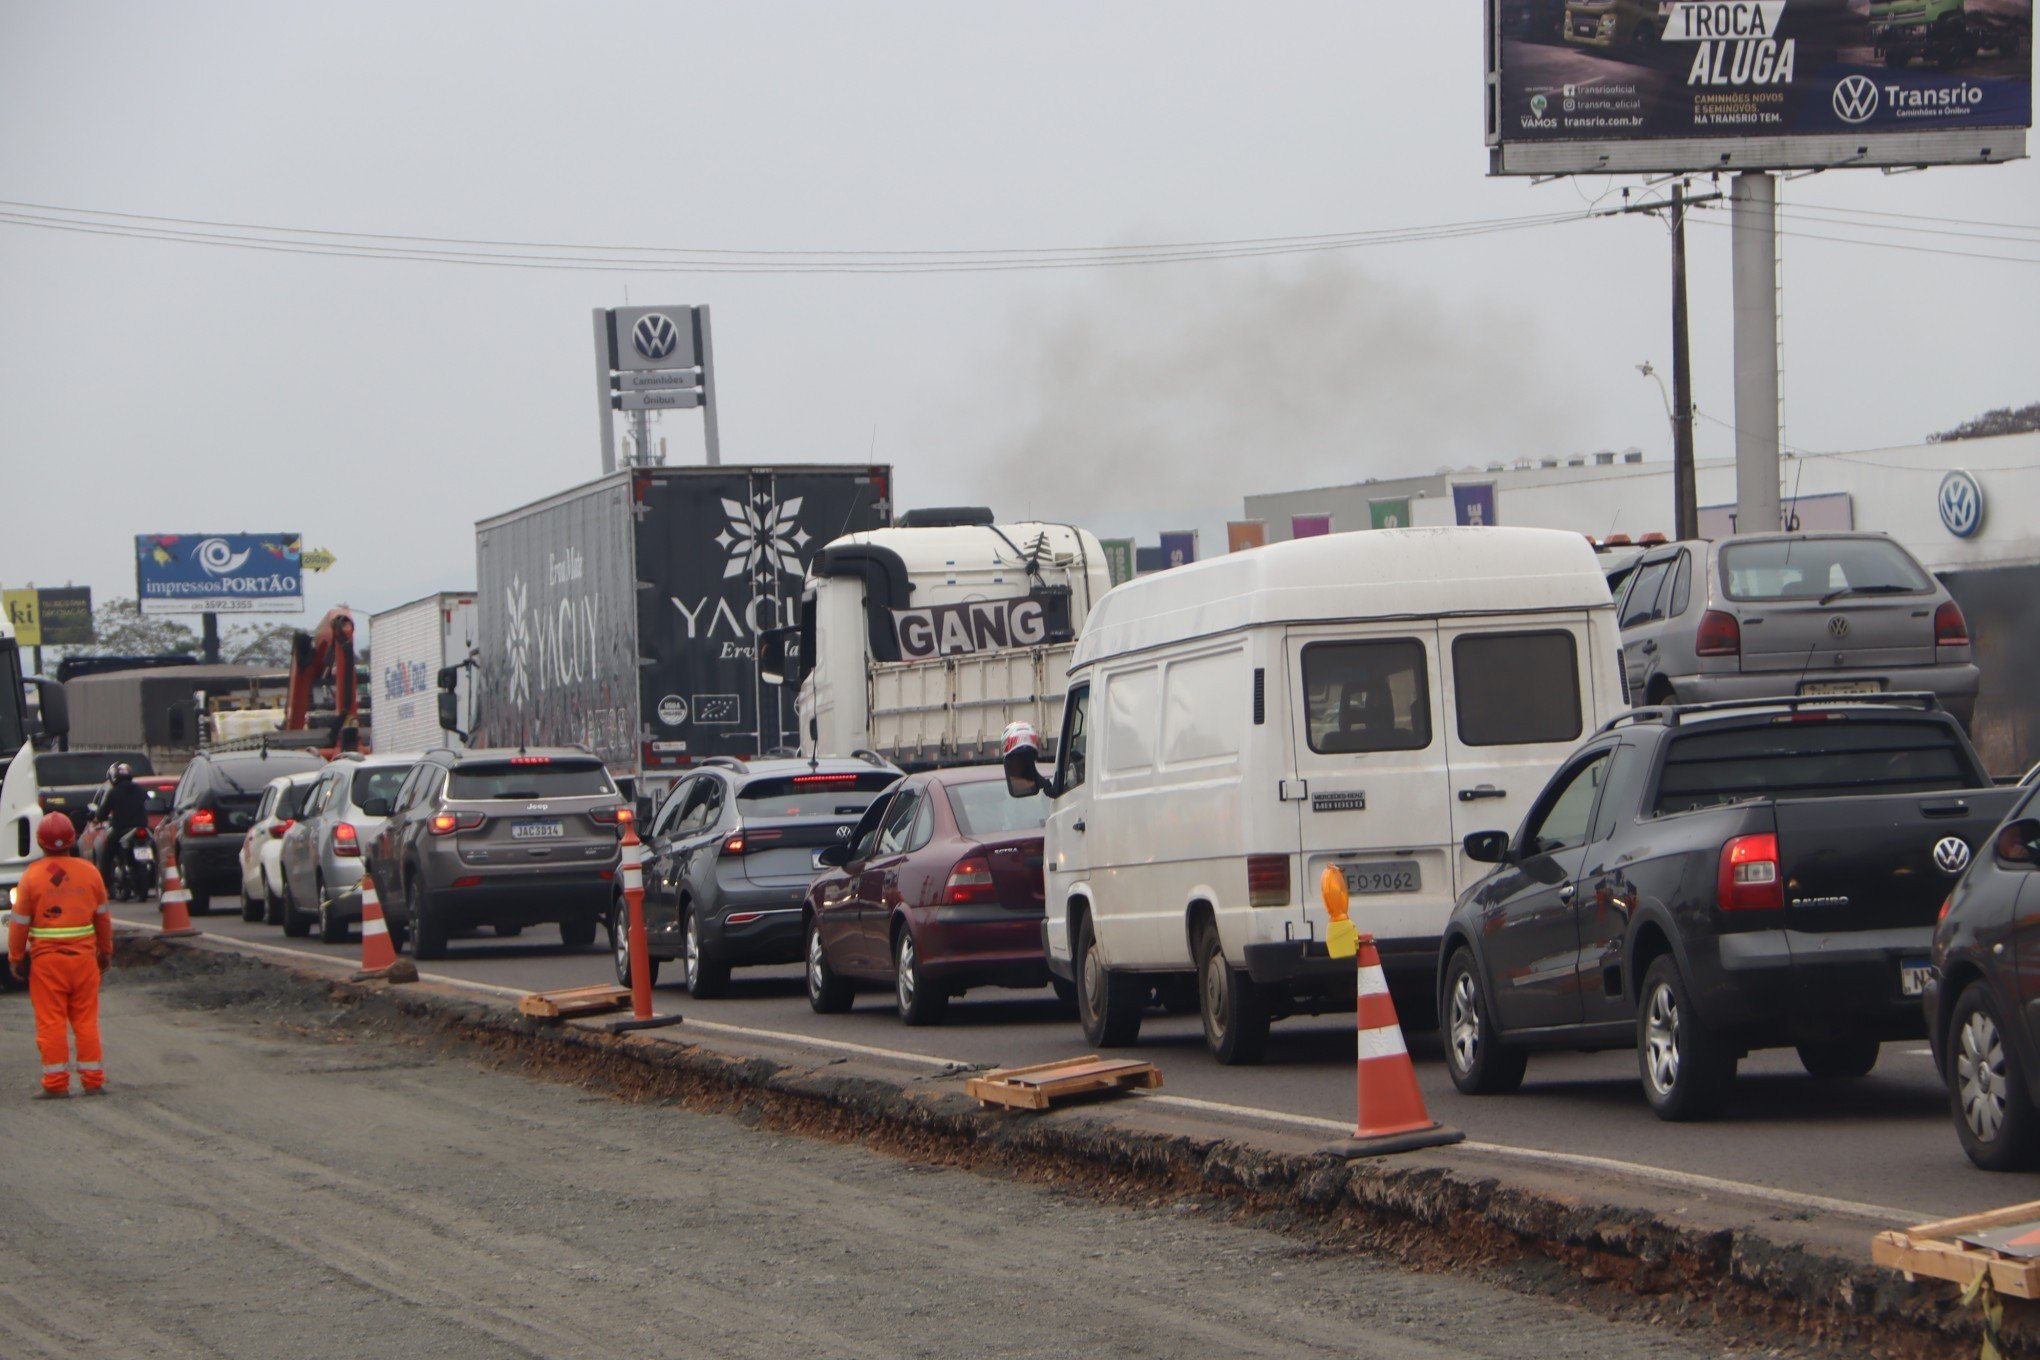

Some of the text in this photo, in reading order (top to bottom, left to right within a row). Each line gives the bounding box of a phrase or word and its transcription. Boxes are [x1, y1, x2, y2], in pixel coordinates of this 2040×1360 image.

[1680, 3, 1766, 37] TROCA
[1686, 38, 1796, 85] ALUGA
[1694, 92, 1784, 104] CAMINHÕES NOVOS
[1884, 82, 1983, 106] Transrio
[1694, 105, 1700, 113] E
[1896, 108, 1937, 117] Caminhões
[1944, 107, 1971, 115] Ônibus
[1521, 118, 1558, 128] VAMOS
[1564, 115, 1644, 127] transrio.com.br
[1694, 113, 1783, 124] NA TRANSRIO TEM.
[632, 376, 684, 386] Caminhões
[643, 395, 676, 404] Ônibus
[899, 600, 1046, 657] GANG
[533, 592, 599, 691] YACUY
[719, 641, 757, 659] Erv
[526, 803, 549, 811] Jeep
[1792, 896, 1850, 908] SAVEIRO
